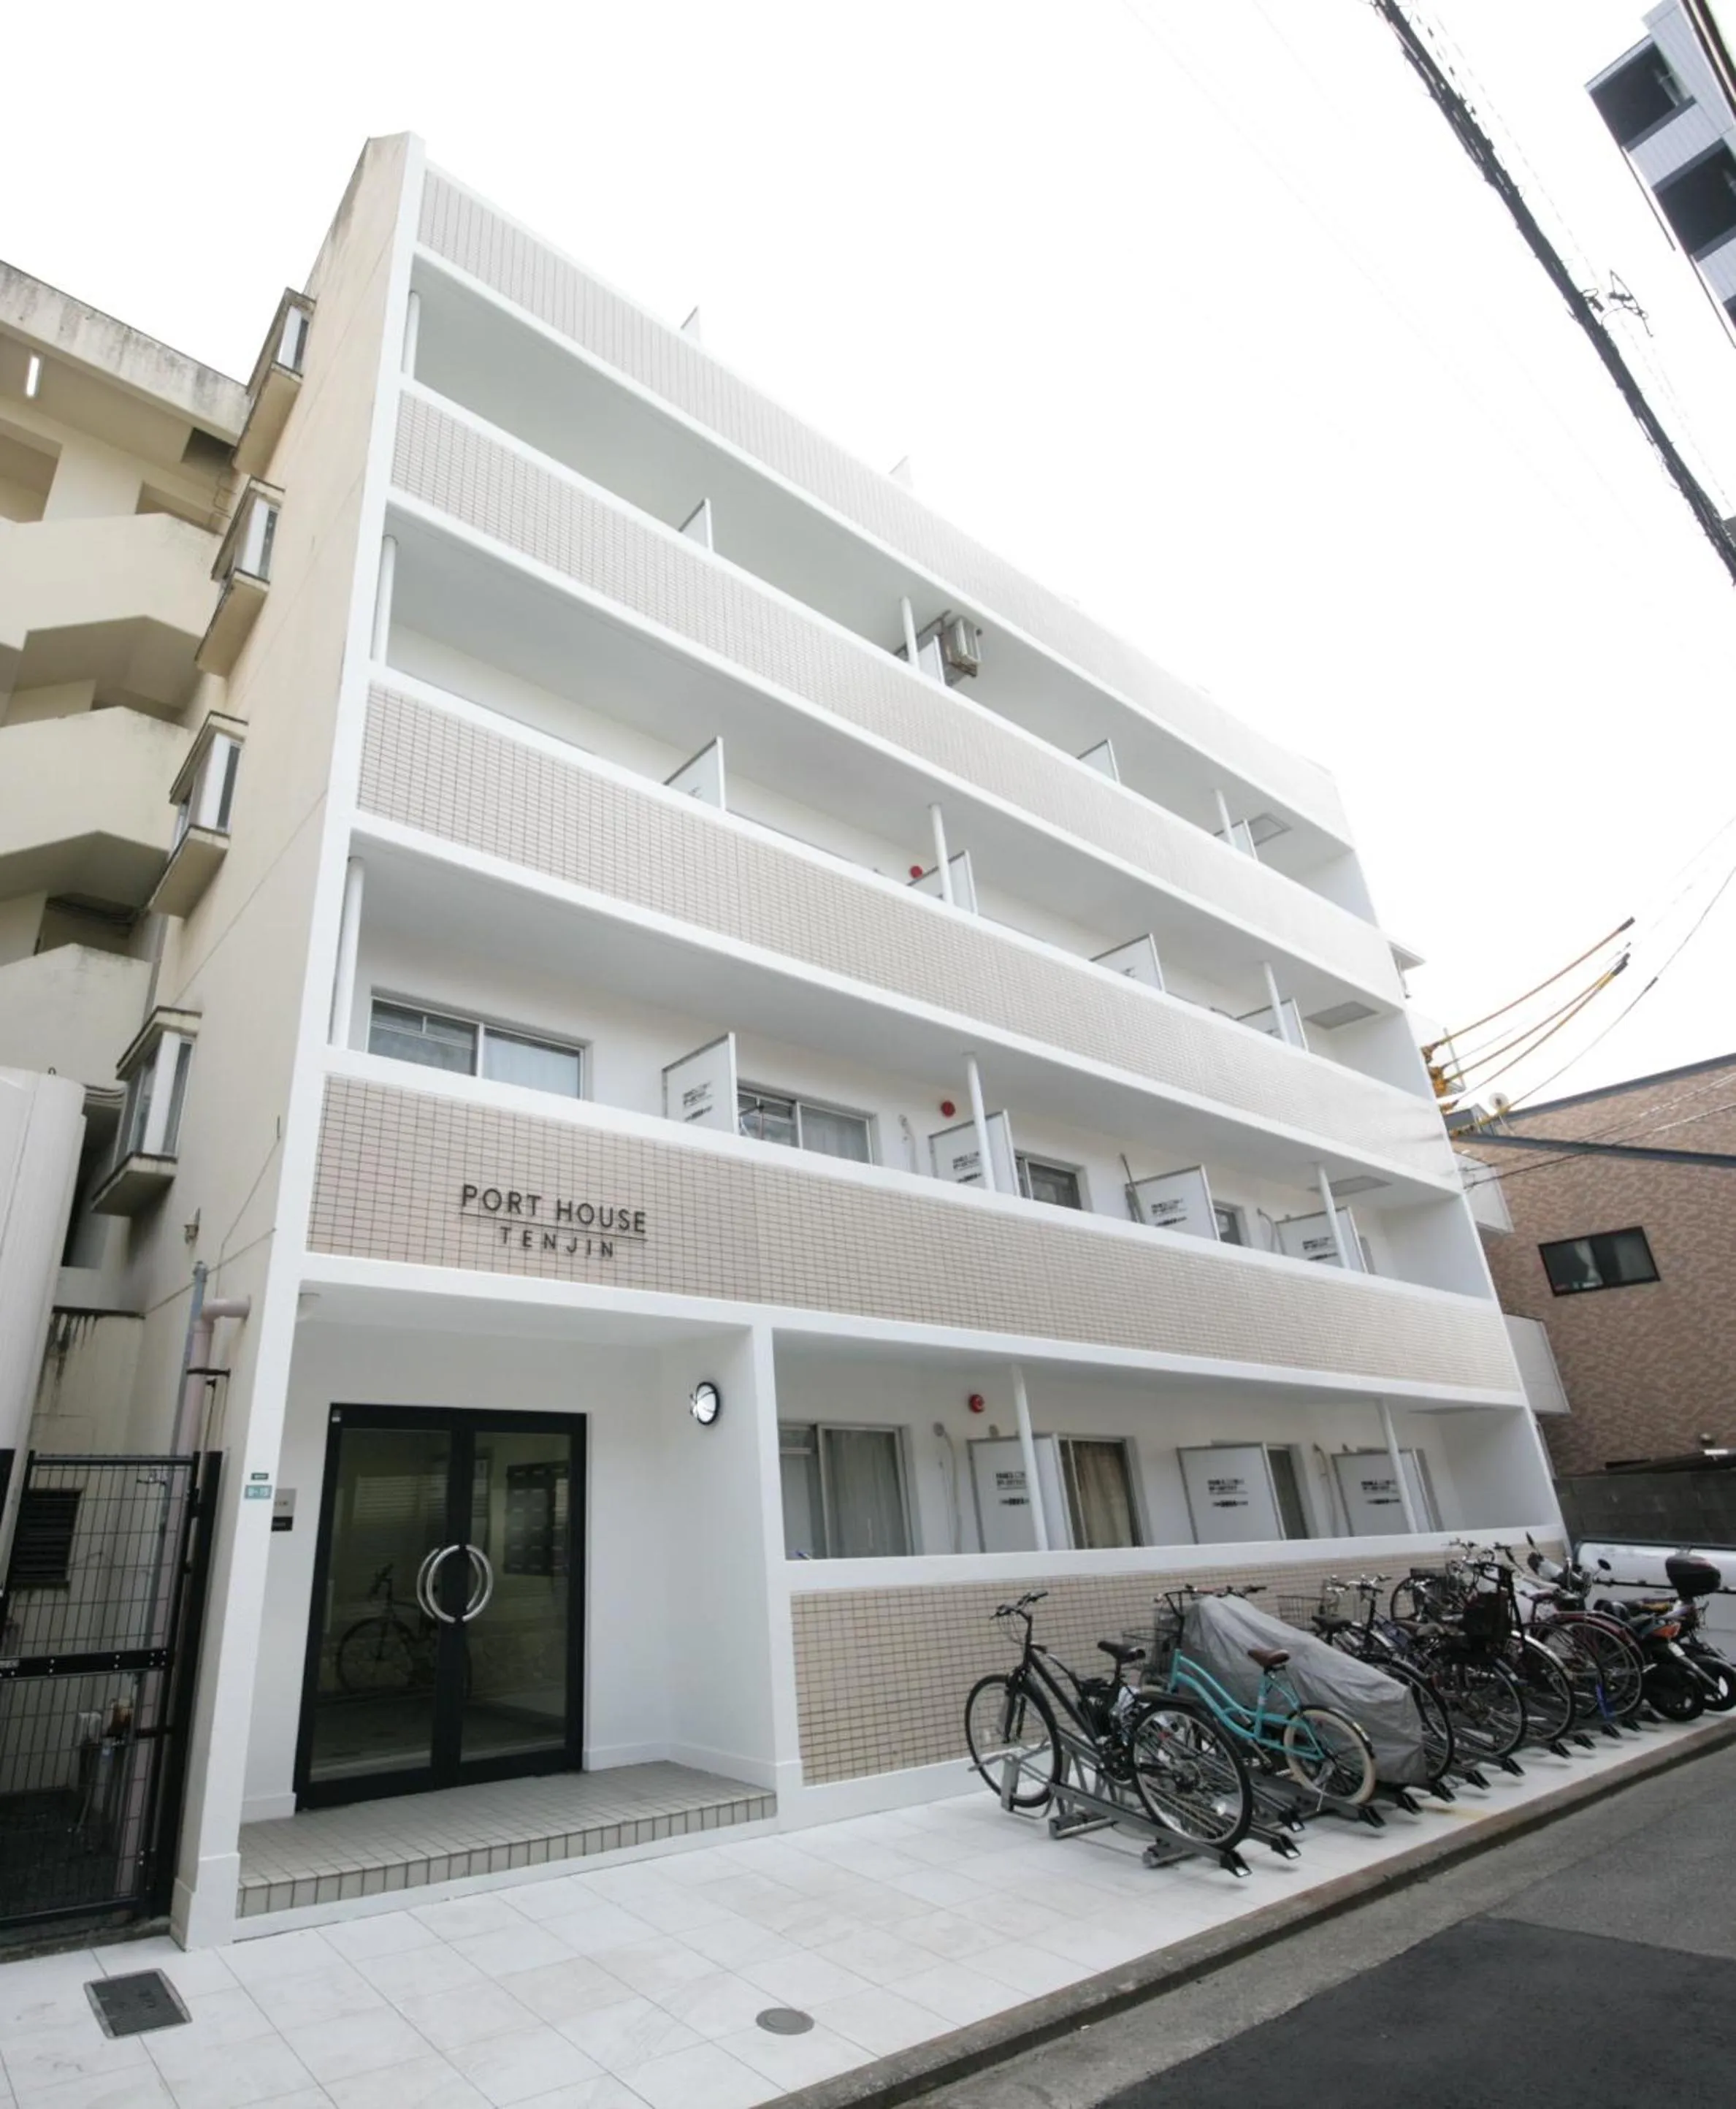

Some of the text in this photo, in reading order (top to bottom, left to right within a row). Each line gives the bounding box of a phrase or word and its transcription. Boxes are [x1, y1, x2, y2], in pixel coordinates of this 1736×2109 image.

[462, 1184, 646, 1233] PORT HOUSE
[500, 1227, 613, 1257] TENJIN
